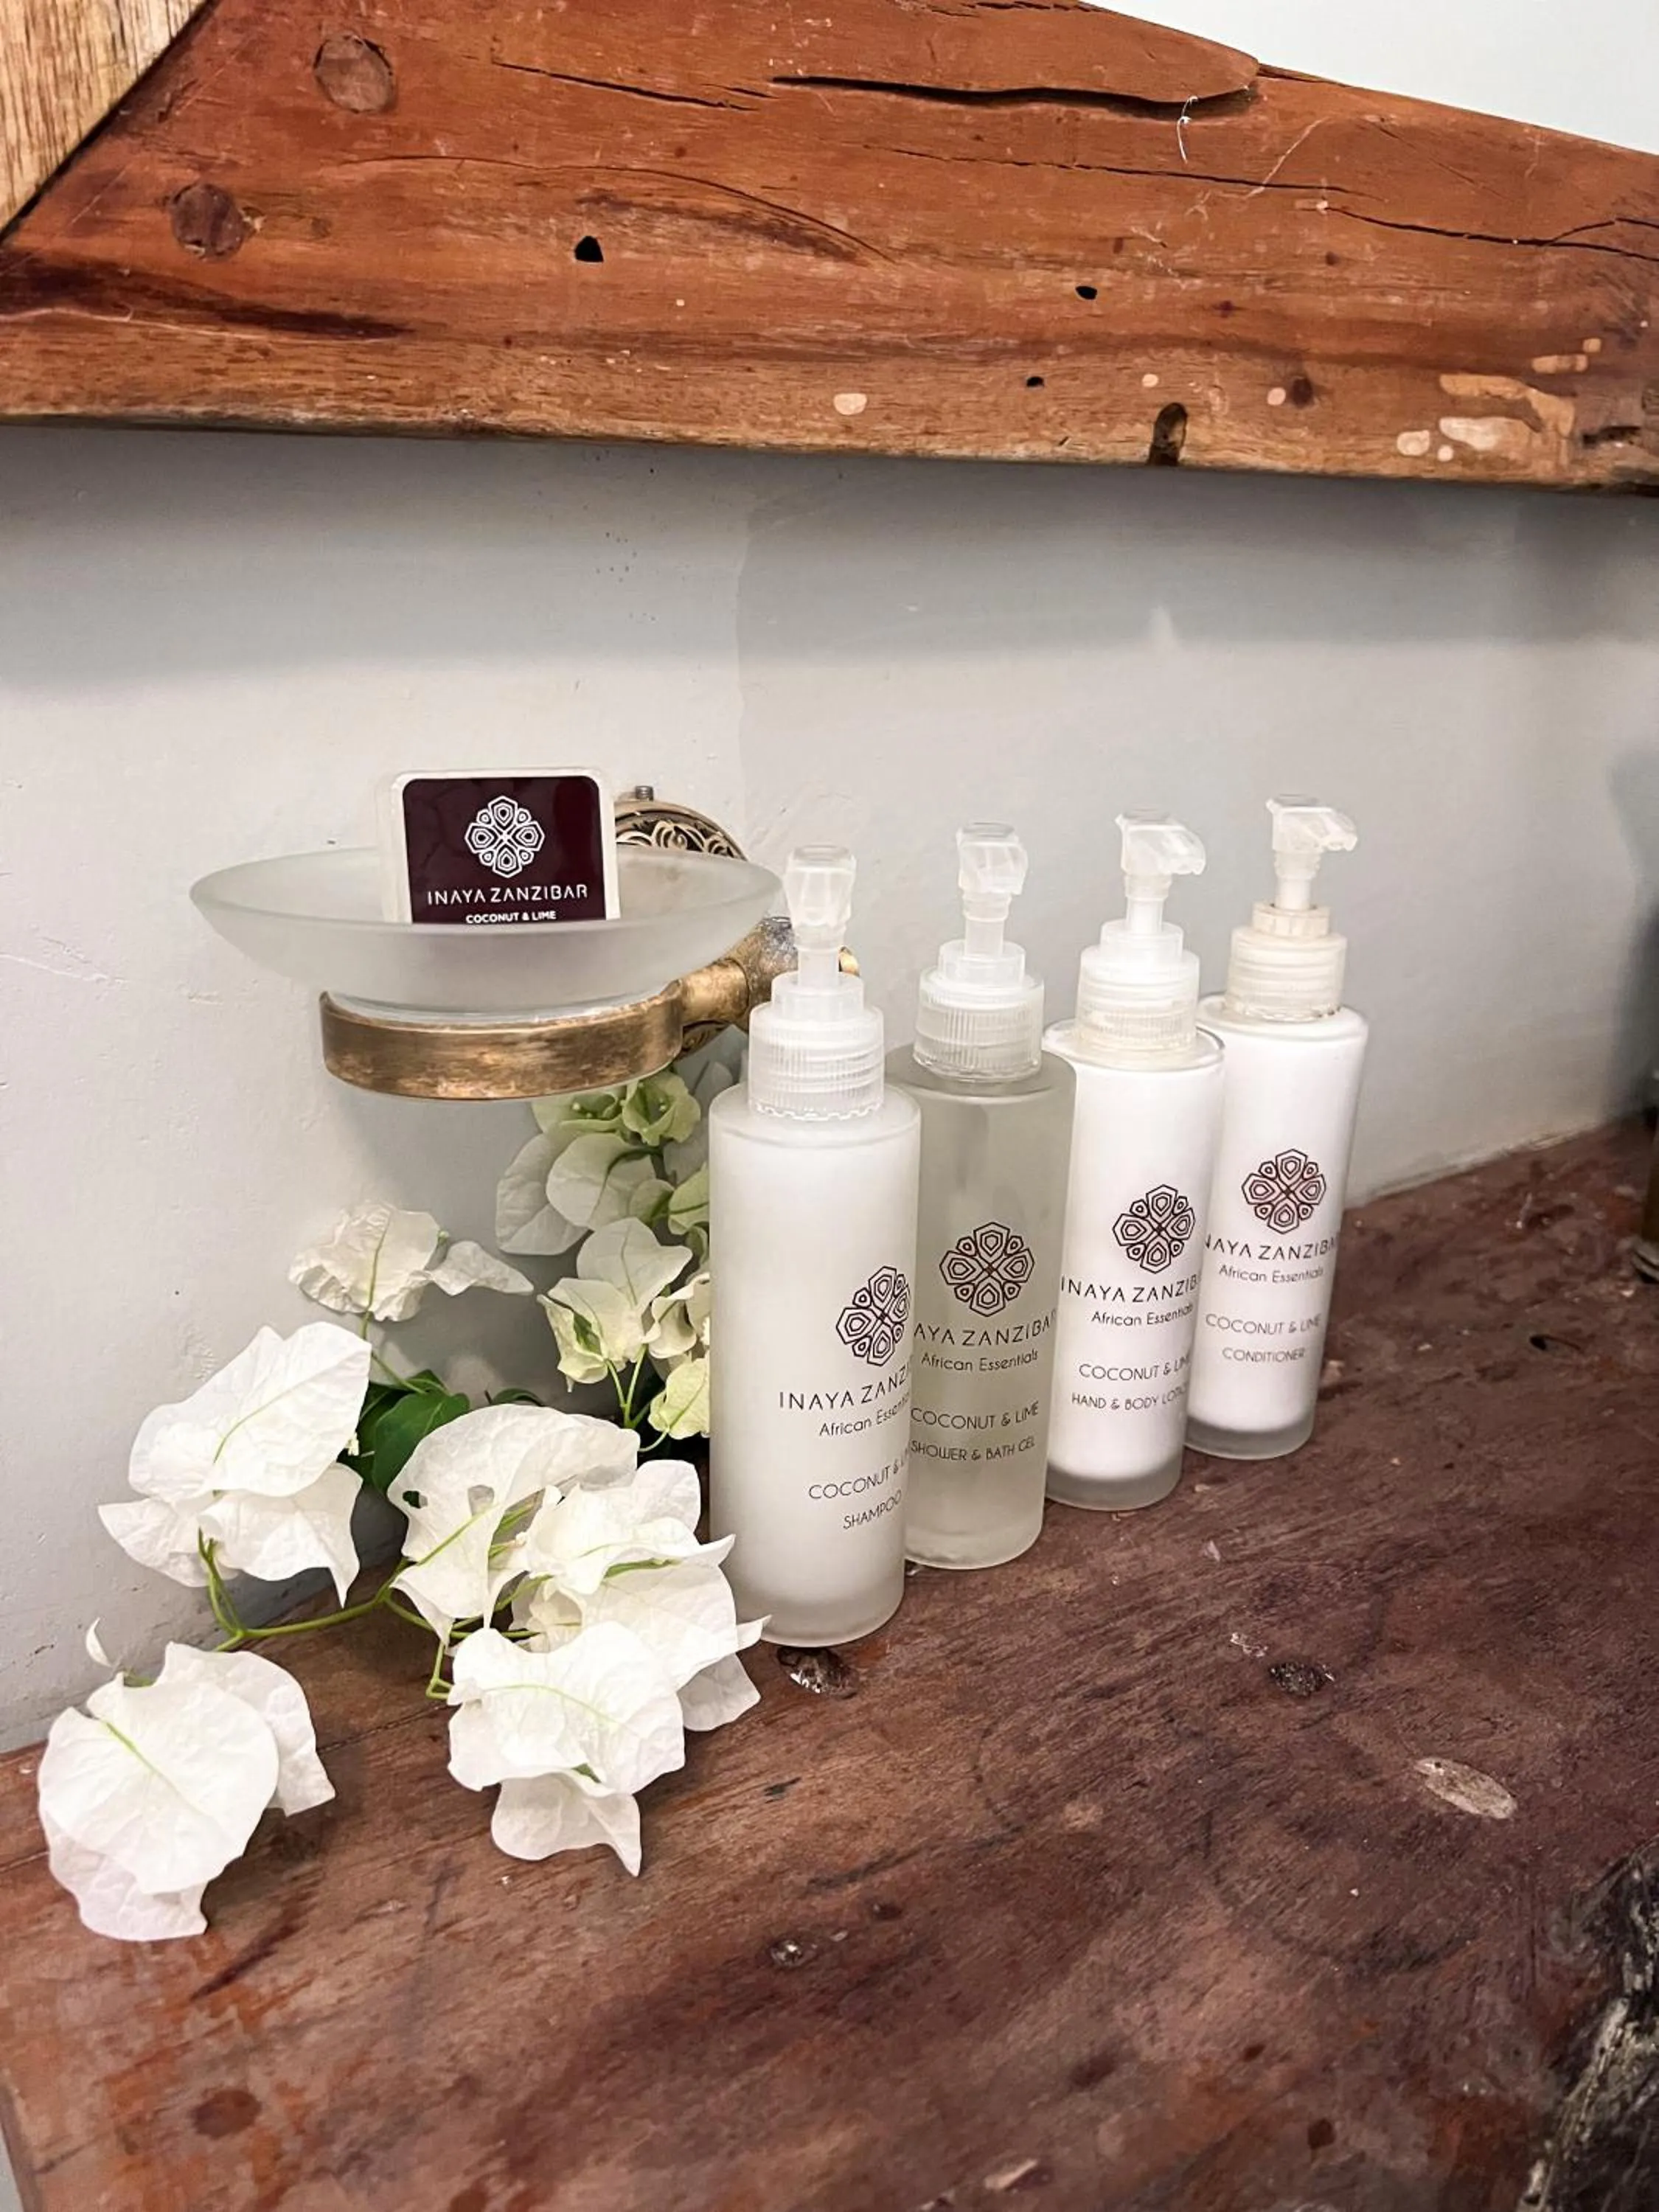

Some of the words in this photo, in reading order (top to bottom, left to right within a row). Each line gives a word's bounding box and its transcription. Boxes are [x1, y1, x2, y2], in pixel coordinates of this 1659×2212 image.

[427, 888, 486, 905] INAYA
[490, 884, 588, 903] ZANZIBAR
[465, 911, 519, 924] COCONUT
[521, 911, 530, 921] &
[532, 910, 557, 921] LIME
[1219, 1265, 1267, 1282] African
[1272, 1265, 1324, 1283] Essentials
[1060, 1276, 1125, 1302] INAYA
[1133, 1274, 1197, 1303] ZANZIB
[1091, 1310, 1141, 1327] African
[1206, 1313, 1284, 1335] COCONUT
[1300, 1312, 1321, 1332] LIME
[914, 1323, 955, 1346] AYA
[922, 1353, 973, 1372] African
[979, 1348, 1038, 1372] Essentials
[1222, 1347, 1306, 1363] CONDITIONER
[1079, 1364, 1160, 1382] COCONUT
[1163, 1362, 1172, 1376] &
[779, 1391, 854, 1410] INAYA
[1072, 1391, 1106, 1411] HAND
[1111, 1398, 1120, 1411] &
[1124, 1396, 1159, 1411] BODY
[911, 1408, 996, 1430] COCONUT
[1001, 1412, 1011, 1427] &
[1015, 1400, 1039, 1423] LIME
[818, 1417, 872, 1436] African
[911, 1440, 967, 1461] SHOWER
[971, 1449, 981, 1461] &
[986, 1443, 1015, 1461] BATH
[1018, 1436, 1035, 1452] GEL
[809, 1466, 891, 1500] COCONUT
[843, 1489, 902, 1529] SHAMPOO
